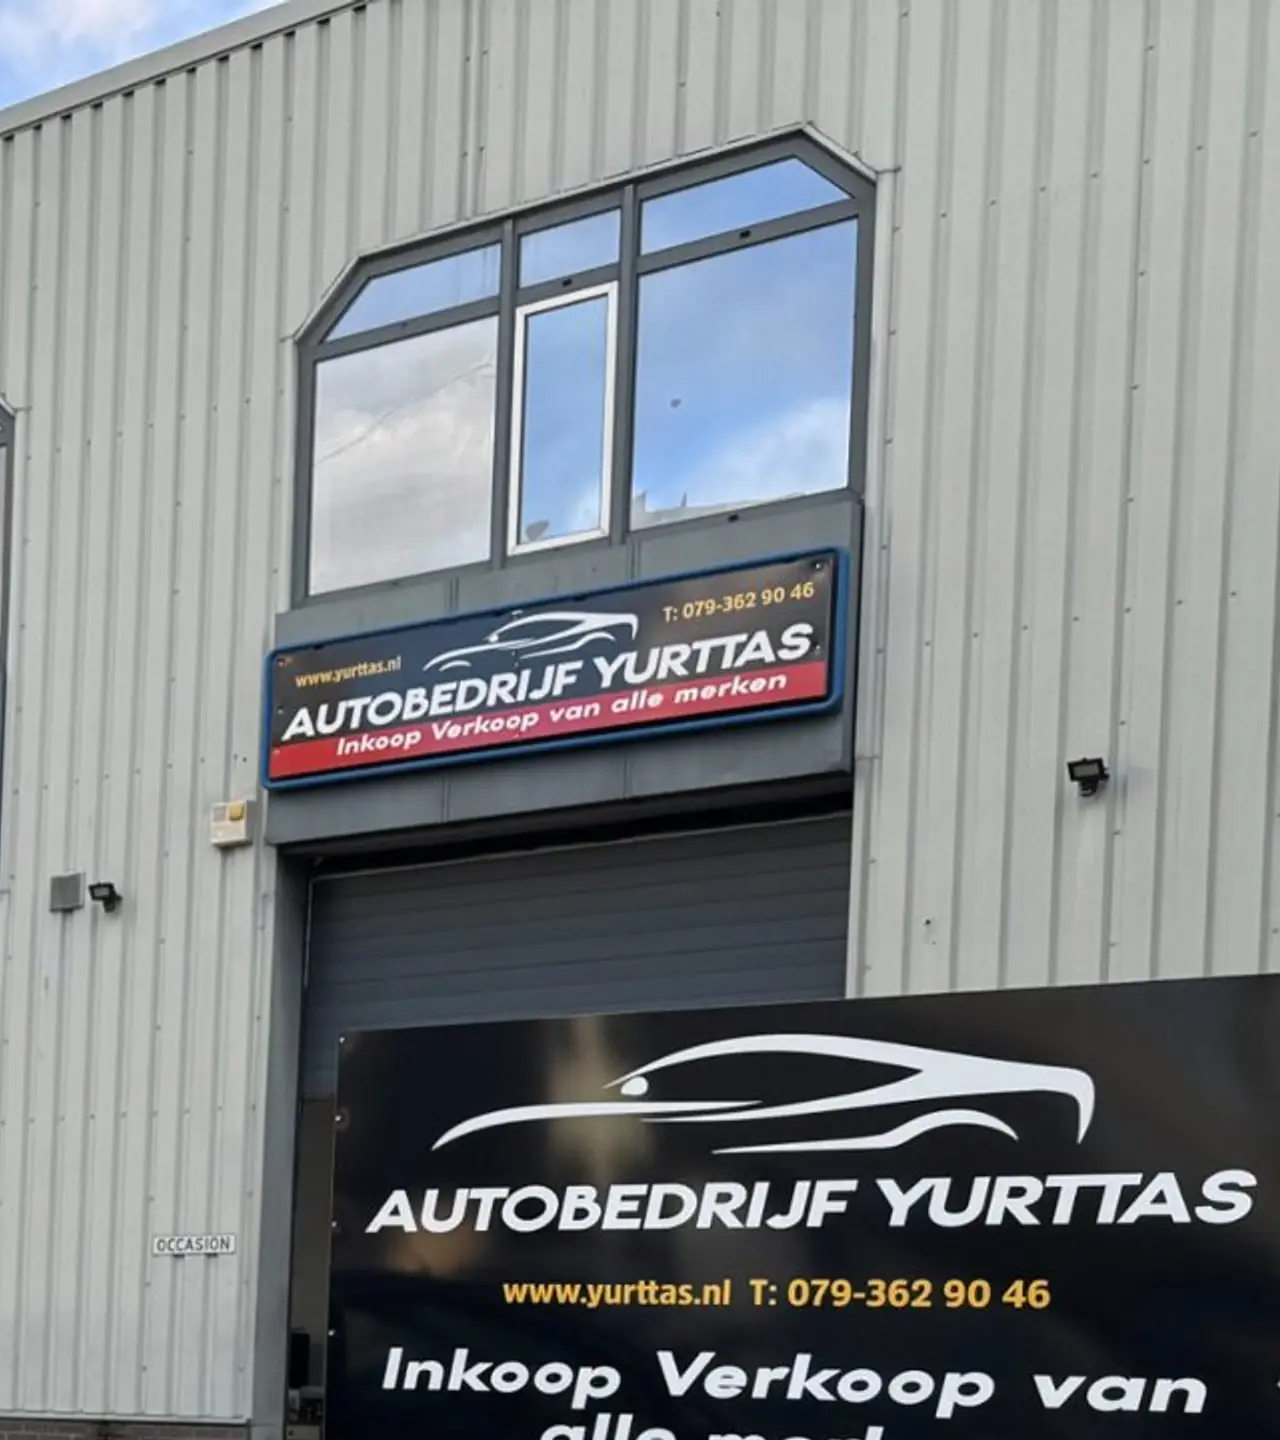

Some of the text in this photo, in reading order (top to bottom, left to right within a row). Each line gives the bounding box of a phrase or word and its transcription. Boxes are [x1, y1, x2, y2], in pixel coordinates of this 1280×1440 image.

[663, 581, 815, 622] T: 079-362 90 46
[281, 622, 814, 742] AUTOBEDRIJF YURTTAS
[295, 655, 402, 688] www.yurttas.nl
[336, 673, 787, 755] Inkoop Verkoop van alle merken
[365, 1169, 1258, 1233] AUTOBEDRIJF YURTTAS
[156, 1236, 230, 1252] OCCASION
[503, 1278, 1052, 1308] www.yurttas.nl T: 079-362 90 46
[382, 1346, 1208, 1419] Inkoop Verkoop van
